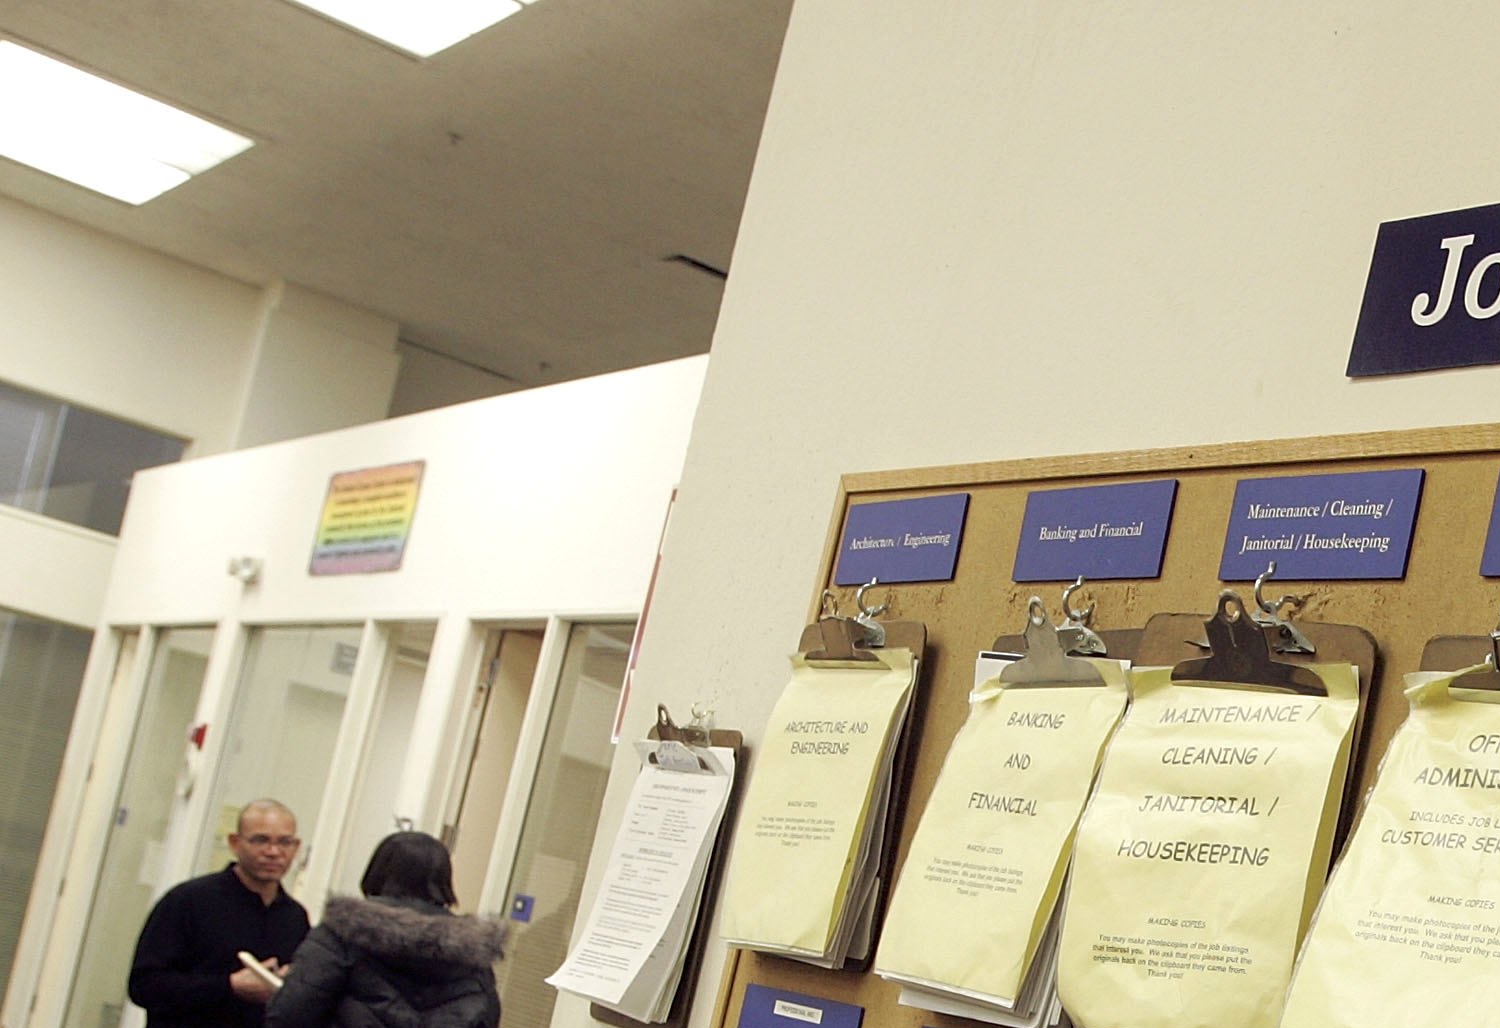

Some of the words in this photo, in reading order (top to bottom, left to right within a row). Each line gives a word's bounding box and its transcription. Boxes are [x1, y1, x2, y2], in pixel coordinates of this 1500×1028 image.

[1247, 503, 1320, 519] Maintenance
[1321, 501, 1328, 517] /
[1330, 499, 1384, 518] Cleaning
[1385, 498, 1393, 515] /
[1039, 526, 1078, 543] Banking
[1078, 524, 1098, 539] and
[1098, 522, 1144, 538] Financial
[1238, 533, 1294, 554] Janitorial
[1294, 534, 1302, 550] /
[1302, 531, 1390, 552] Housekeeping
[1006, 711, 1065, 729] BANKING
[1158, 704, 1302, 726] MAINTENANCE
[1305, 703, 1322, 721] /
[784, 720, 847, 734] ARCHITECTURE
[847, 721, 868, 734] AND
[790, 741, 849, 755] ENGINEERING
[1161, 746, 1258, 765] CLEANING
[1263, 747, 1277, 765] /
[1003, 752, 1030, 770] AND
[967, 791, 1037, 816] FINANCIAL
[1138, 792, 1259, 816] JANITORIAL
[1267, 796, 1279, 816] /
[1408, 810, 1464, 824] INCLUDES
[1467, 816, 1491, 827] JOB
[1381, 829, 1466, 848] CUSTOMER
[1116, 839, 1270, 866] HOUSEKEEPING
